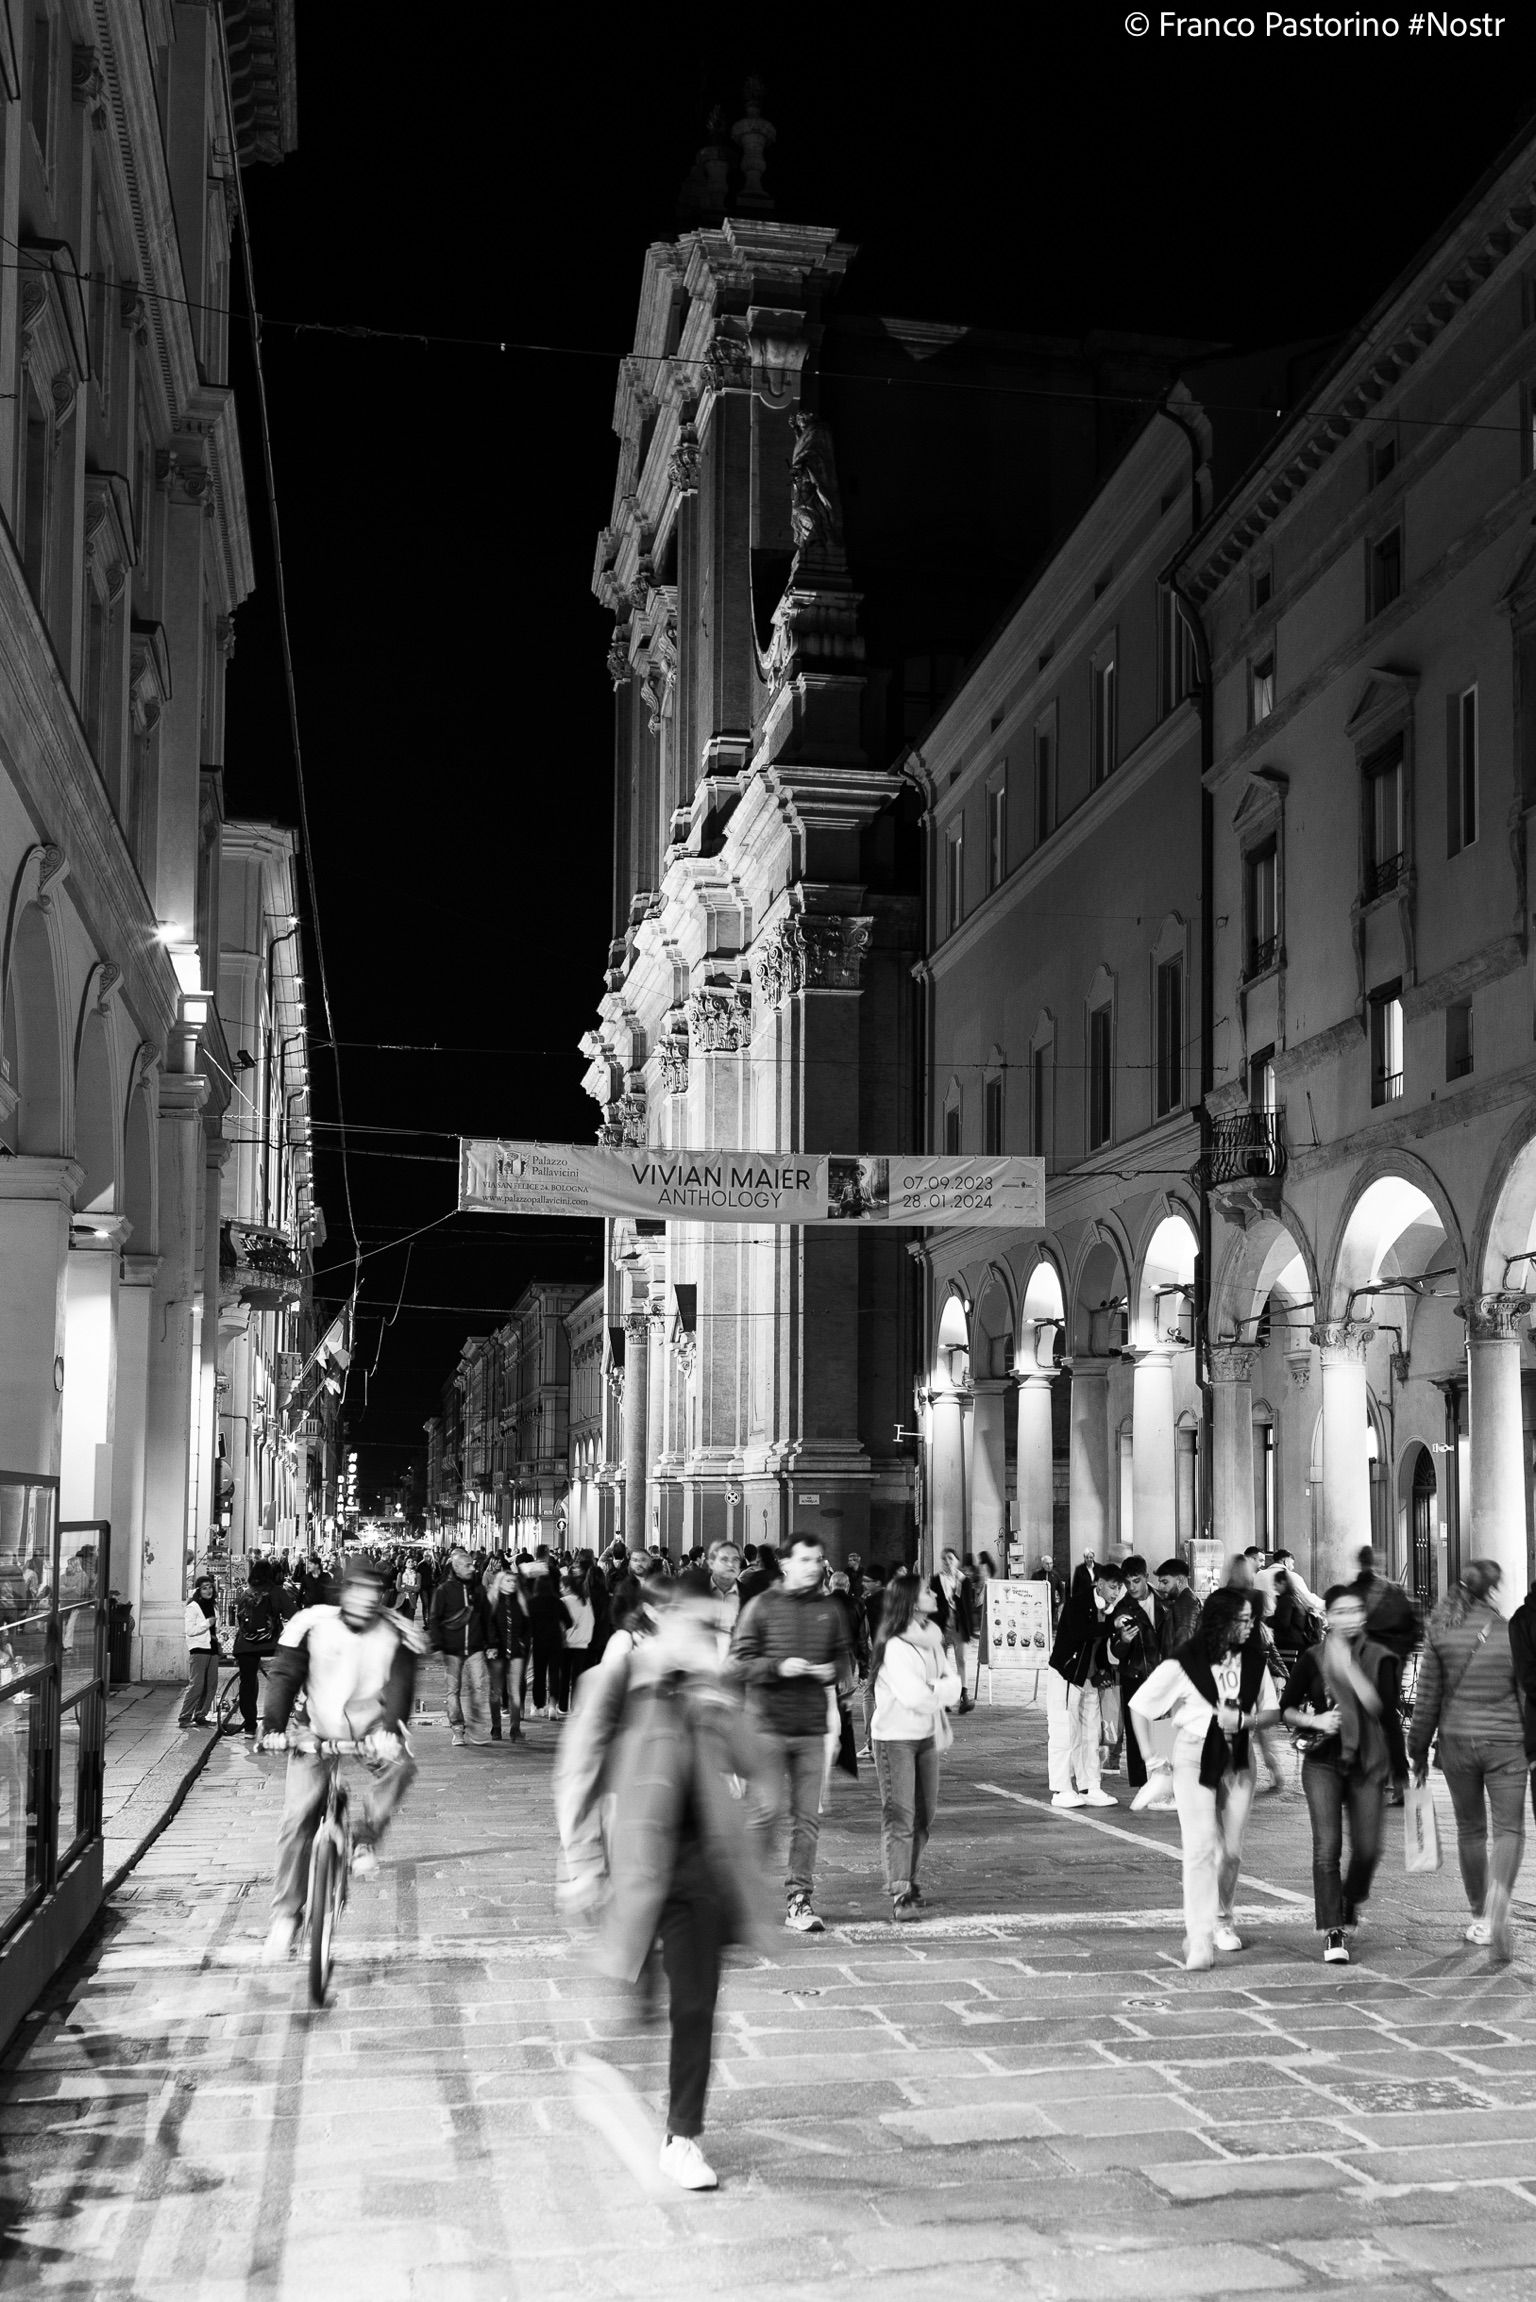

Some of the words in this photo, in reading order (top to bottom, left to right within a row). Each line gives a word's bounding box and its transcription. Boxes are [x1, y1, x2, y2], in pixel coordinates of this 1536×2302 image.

[532, 1155, 568, 1166] Palazzo
[532, 1166, 579, 1178] Pallavicini
[631, 1163, 721, 1187] VIVIAN
[731, 1168, 811, 1190] MAIER
[483, 1181, 496, 1189] VIA
[497, 1182, 512, 1190] SAN
[514, 1182, 539, 1191] FELICE
[551, 1184, 589, 1194] BOLOGNA
[903, 1175, 993, 1191] 07.09.2023
[482, 1194, 589, 1206] www.palazzopallavicini.com
[658, 1188, 783, 1208] ANTHOLOGY
[903, 1193, 993, 1209] 28.01.2024
[347, 1452, 358, 1506] HOTEL
[337, 1474, 345, 1525] DIANA
[1219, 1670, 1238, 1691] 10
